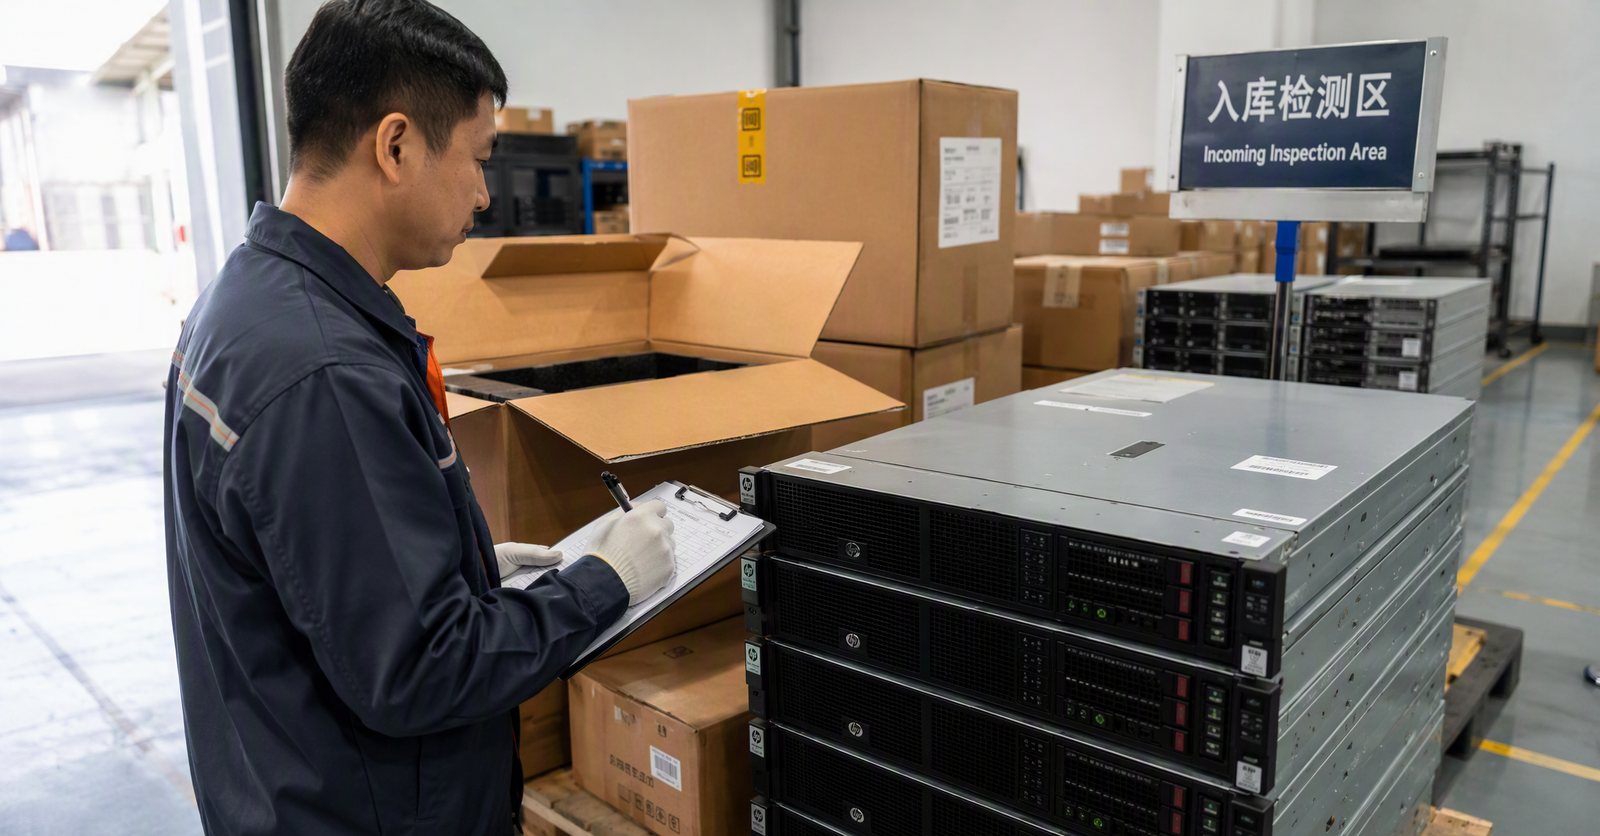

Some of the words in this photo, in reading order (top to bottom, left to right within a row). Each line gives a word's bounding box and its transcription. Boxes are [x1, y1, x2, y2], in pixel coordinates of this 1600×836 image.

[1208, 72, 1392, 124] 入库检测区
[1203, 144, 1266, 167] Incoming
[1269, 142, 1346, 166] Inspection
[1349, 141, 1387, 161] Area
